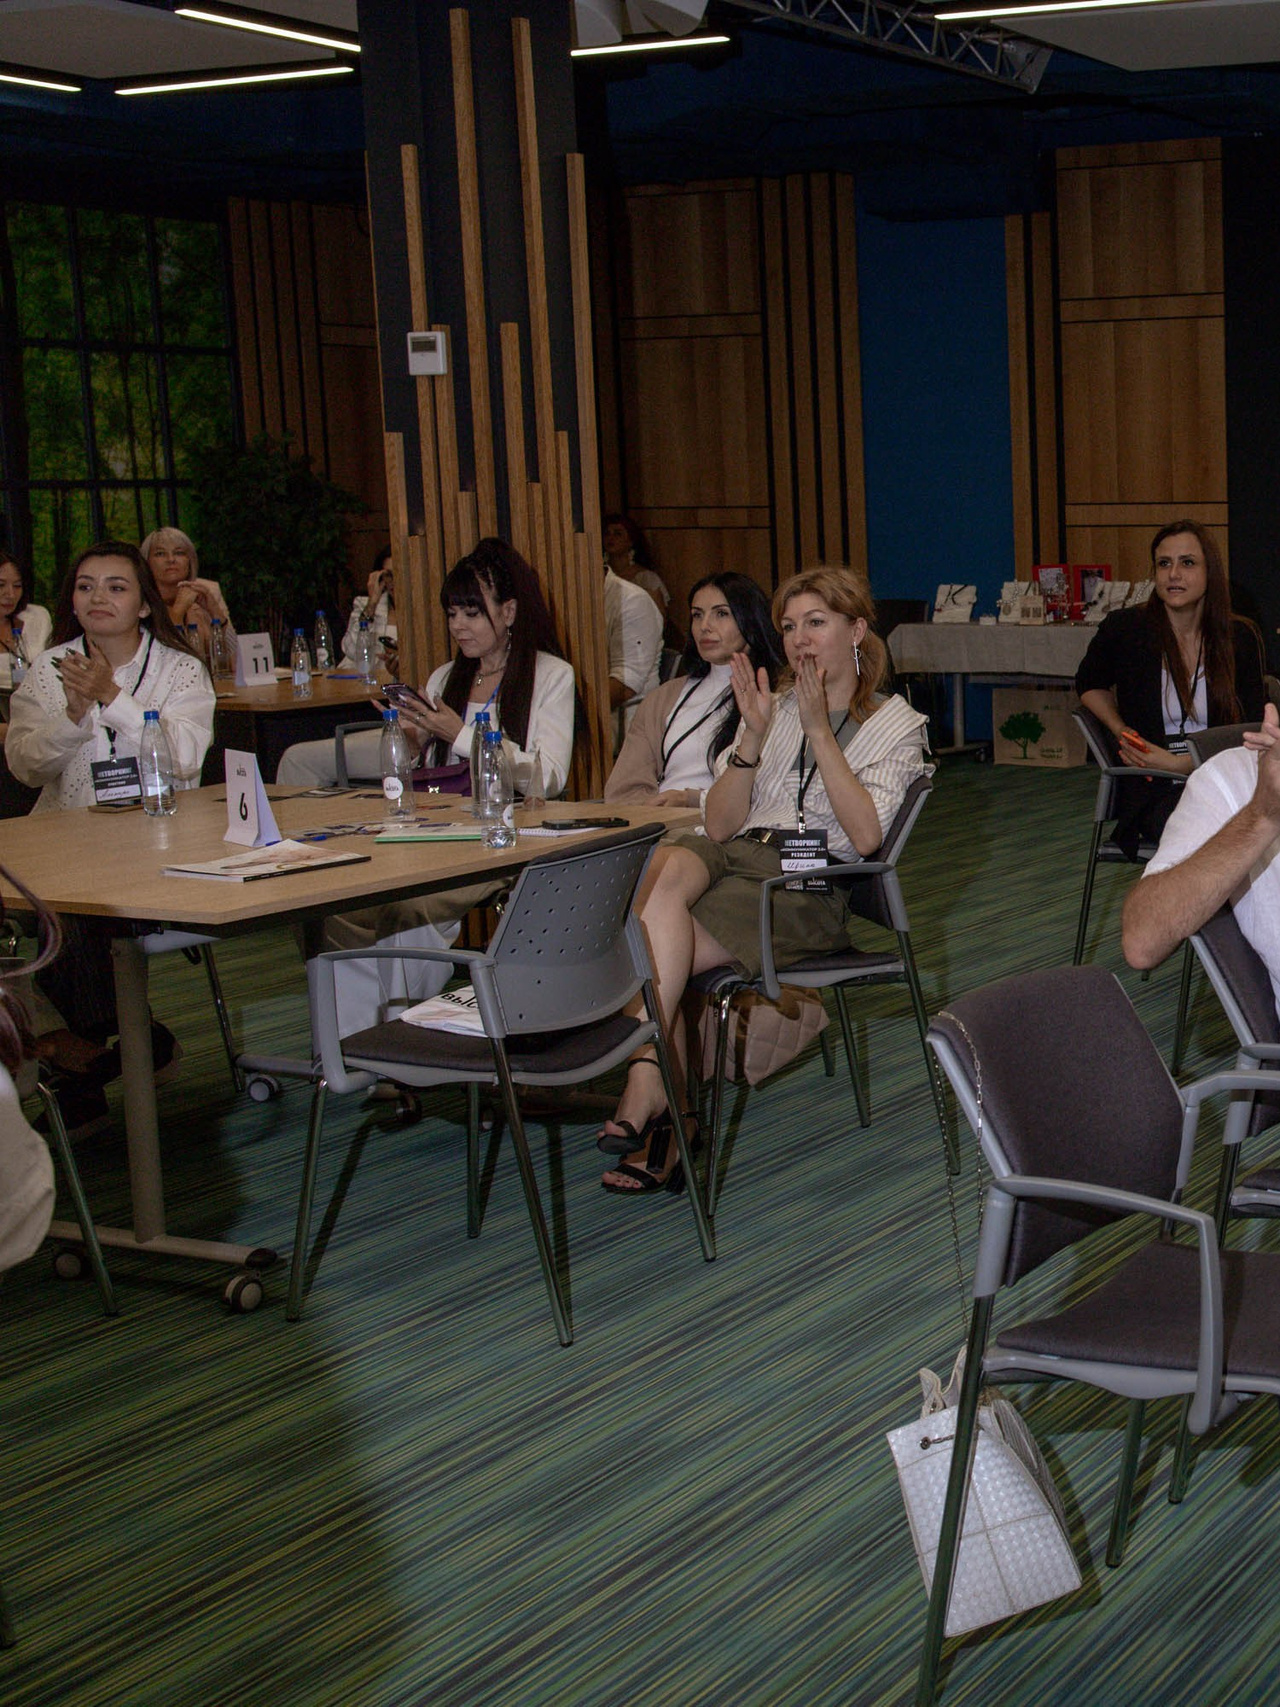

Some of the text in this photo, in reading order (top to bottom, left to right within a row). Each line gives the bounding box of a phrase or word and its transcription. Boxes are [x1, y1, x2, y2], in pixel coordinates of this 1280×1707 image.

[253, 656, 269, 674] 11
[239, 792, 248, 821] 6
[441, 992, 480, 1010] ВЫС
